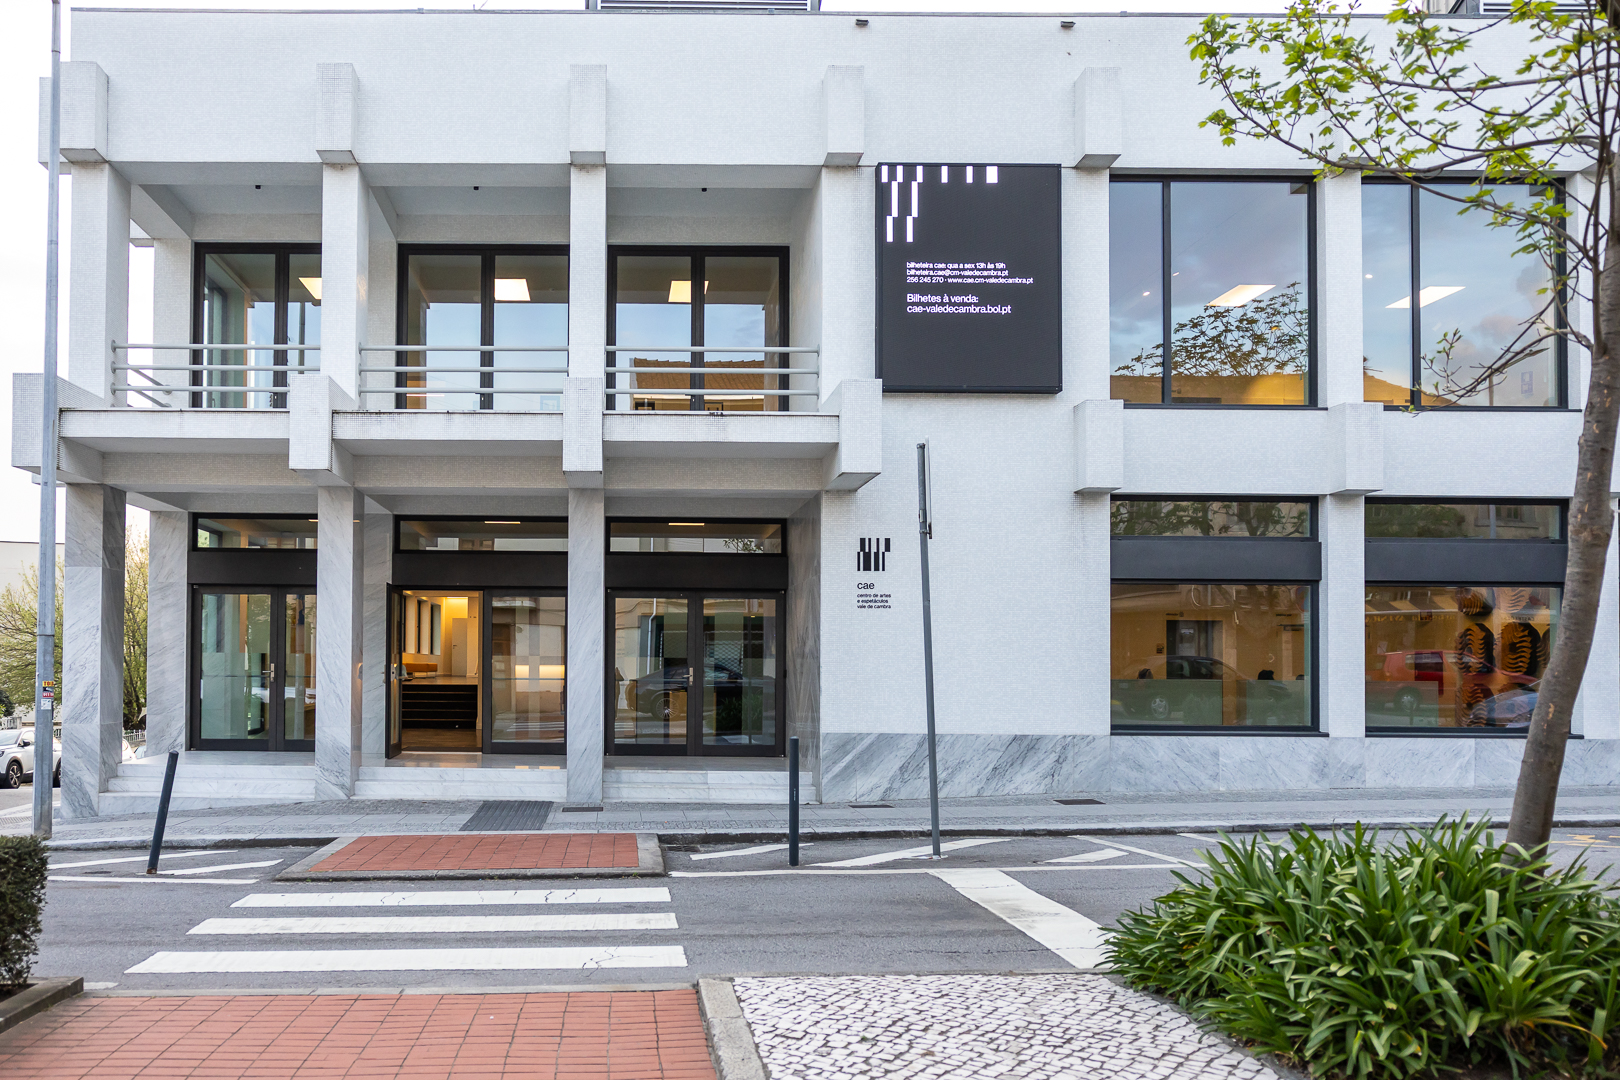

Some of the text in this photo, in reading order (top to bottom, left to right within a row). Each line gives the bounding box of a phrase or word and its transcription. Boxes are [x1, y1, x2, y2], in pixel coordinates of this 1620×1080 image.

[907, 269, 1009, 277] bilheteira.cae@cm-valedecambra.pt
[907, 293, 979, 303] Bilhetes à venda:
[907, 304, 1011, 315] cae-valedecambra.bol.pt
[857, 582, 875, 590] cae
